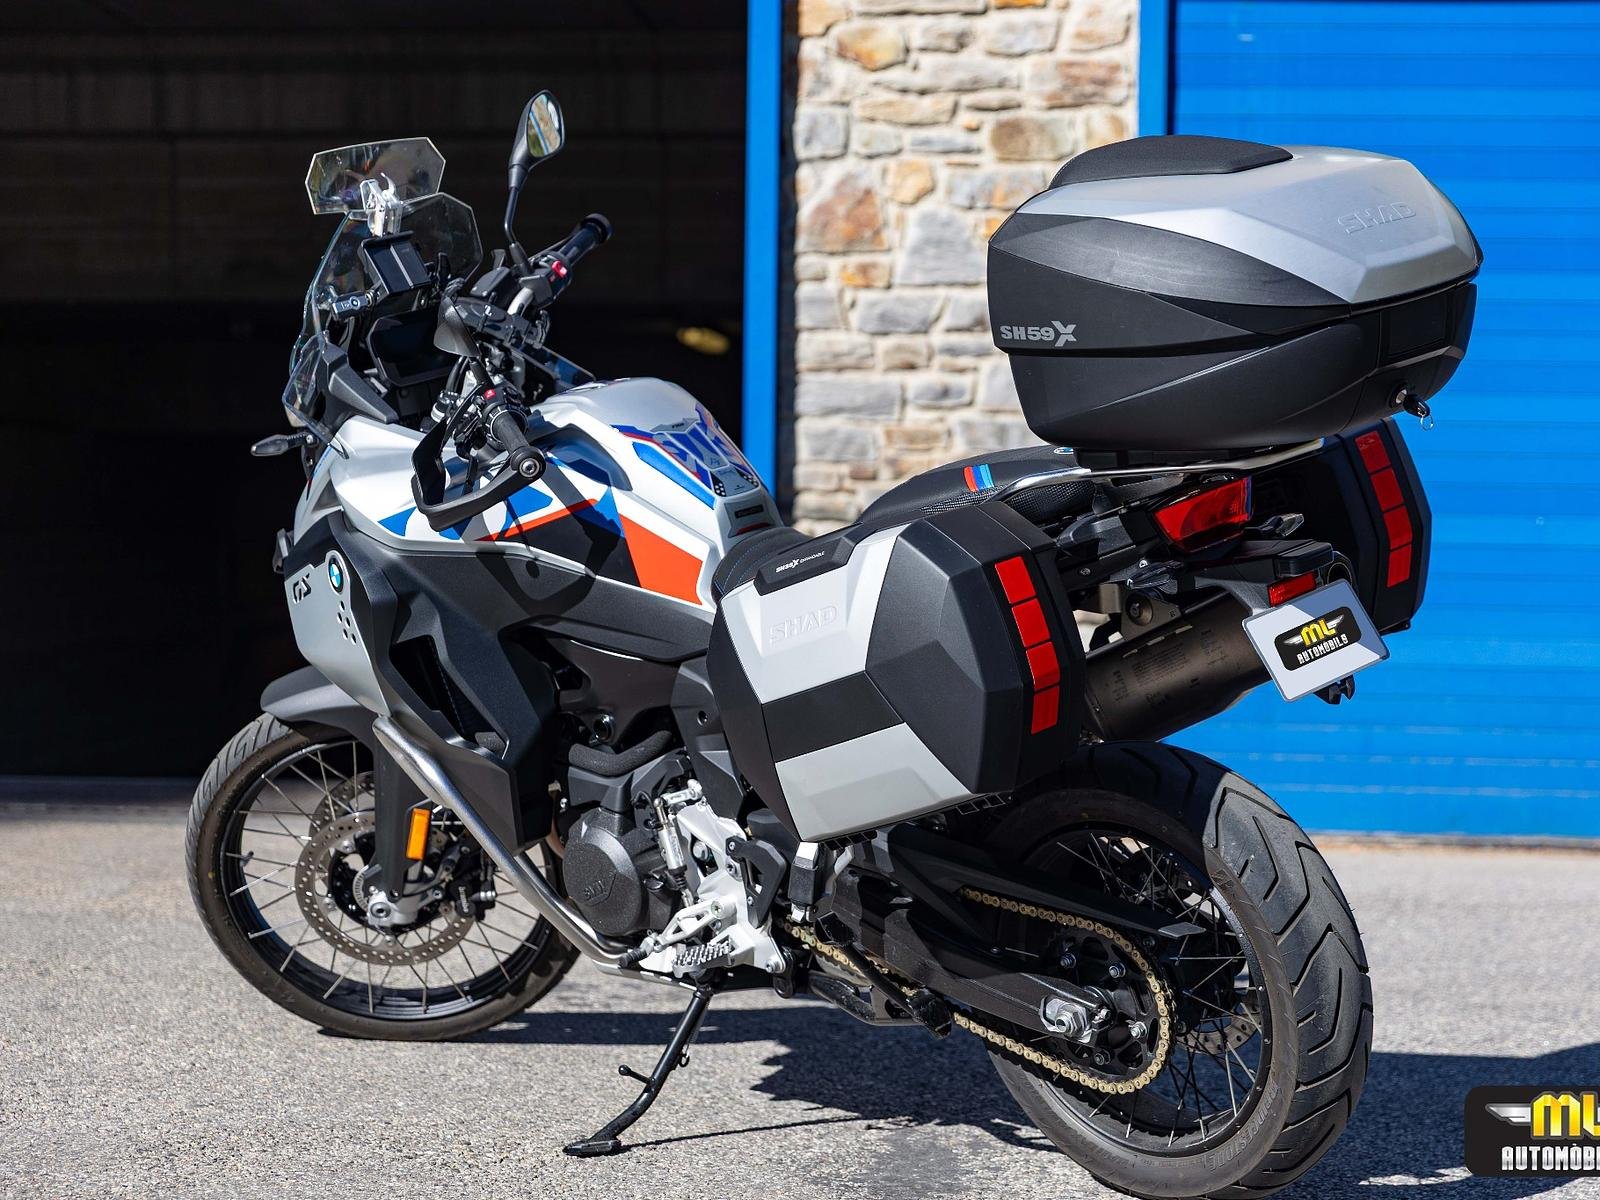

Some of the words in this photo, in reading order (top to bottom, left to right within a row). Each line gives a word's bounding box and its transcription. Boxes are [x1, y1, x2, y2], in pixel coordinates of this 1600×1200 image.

[1337, 202, 1416, 234] SHAD
[1000, 320, 1077, 347] SH59X
[769, 605, 838, 645] SHAD
